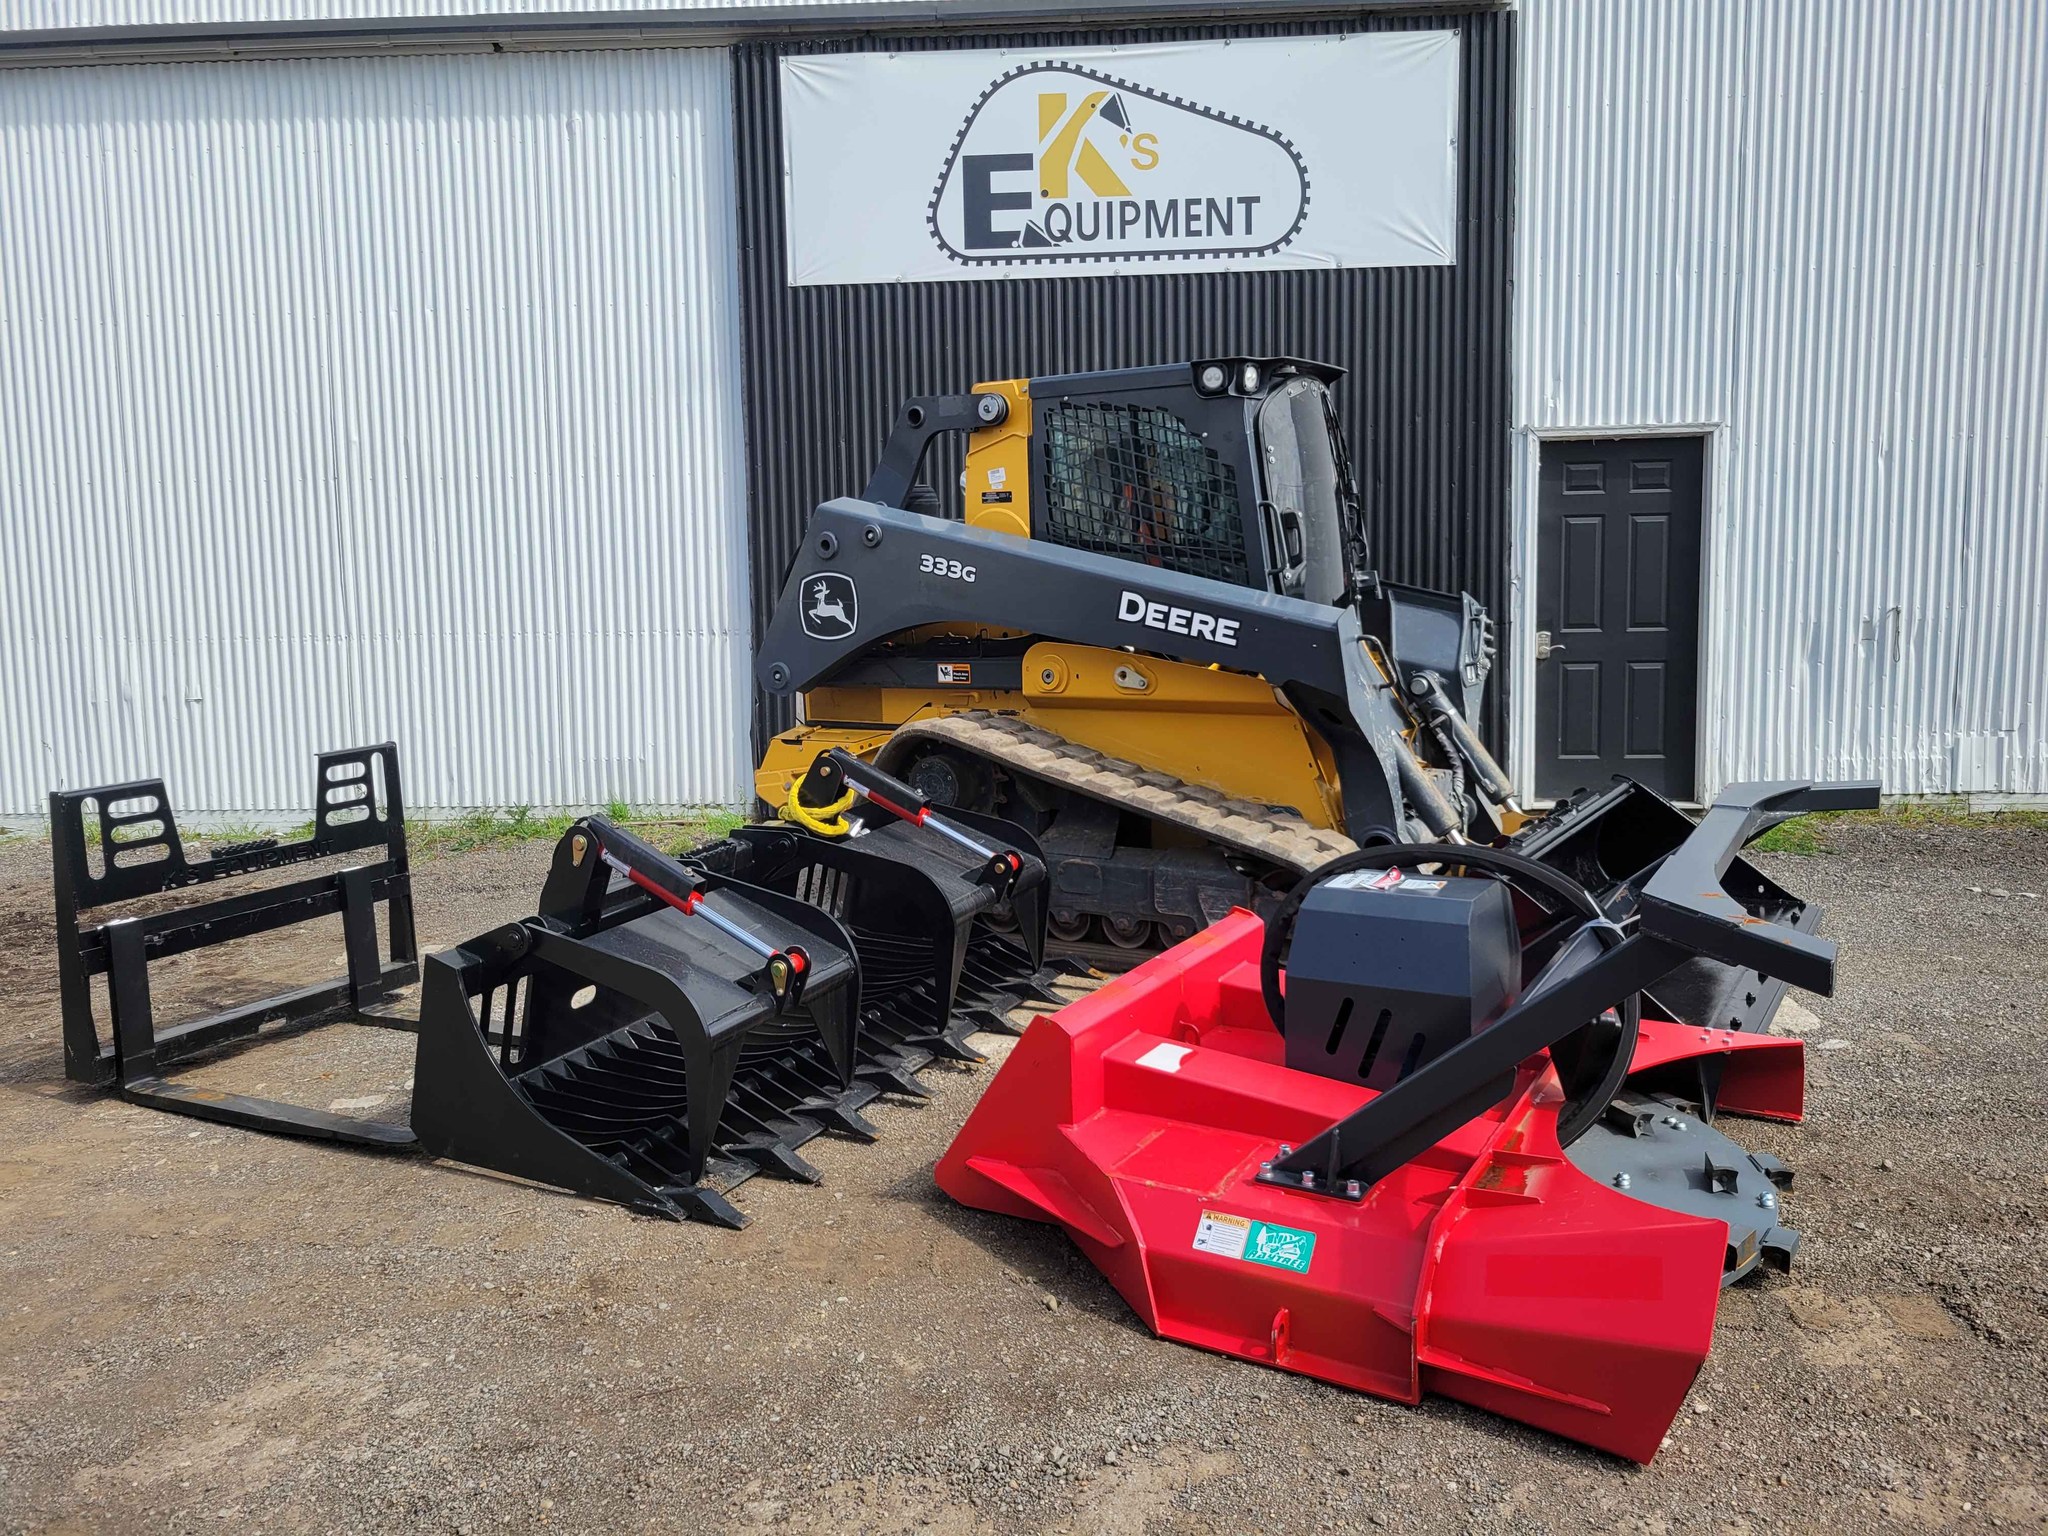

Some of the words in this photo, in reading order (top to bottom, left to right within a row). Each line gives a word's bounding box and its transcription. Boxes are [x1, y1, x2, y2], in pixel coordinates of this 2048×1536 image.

[920, 554, 977, 583] 333G
[1118, 591, 1240, 645] DEERE
[213, 839, 334, 877] EQUIPMENT
[1213, 1214, 1246, 1227] WARNING
